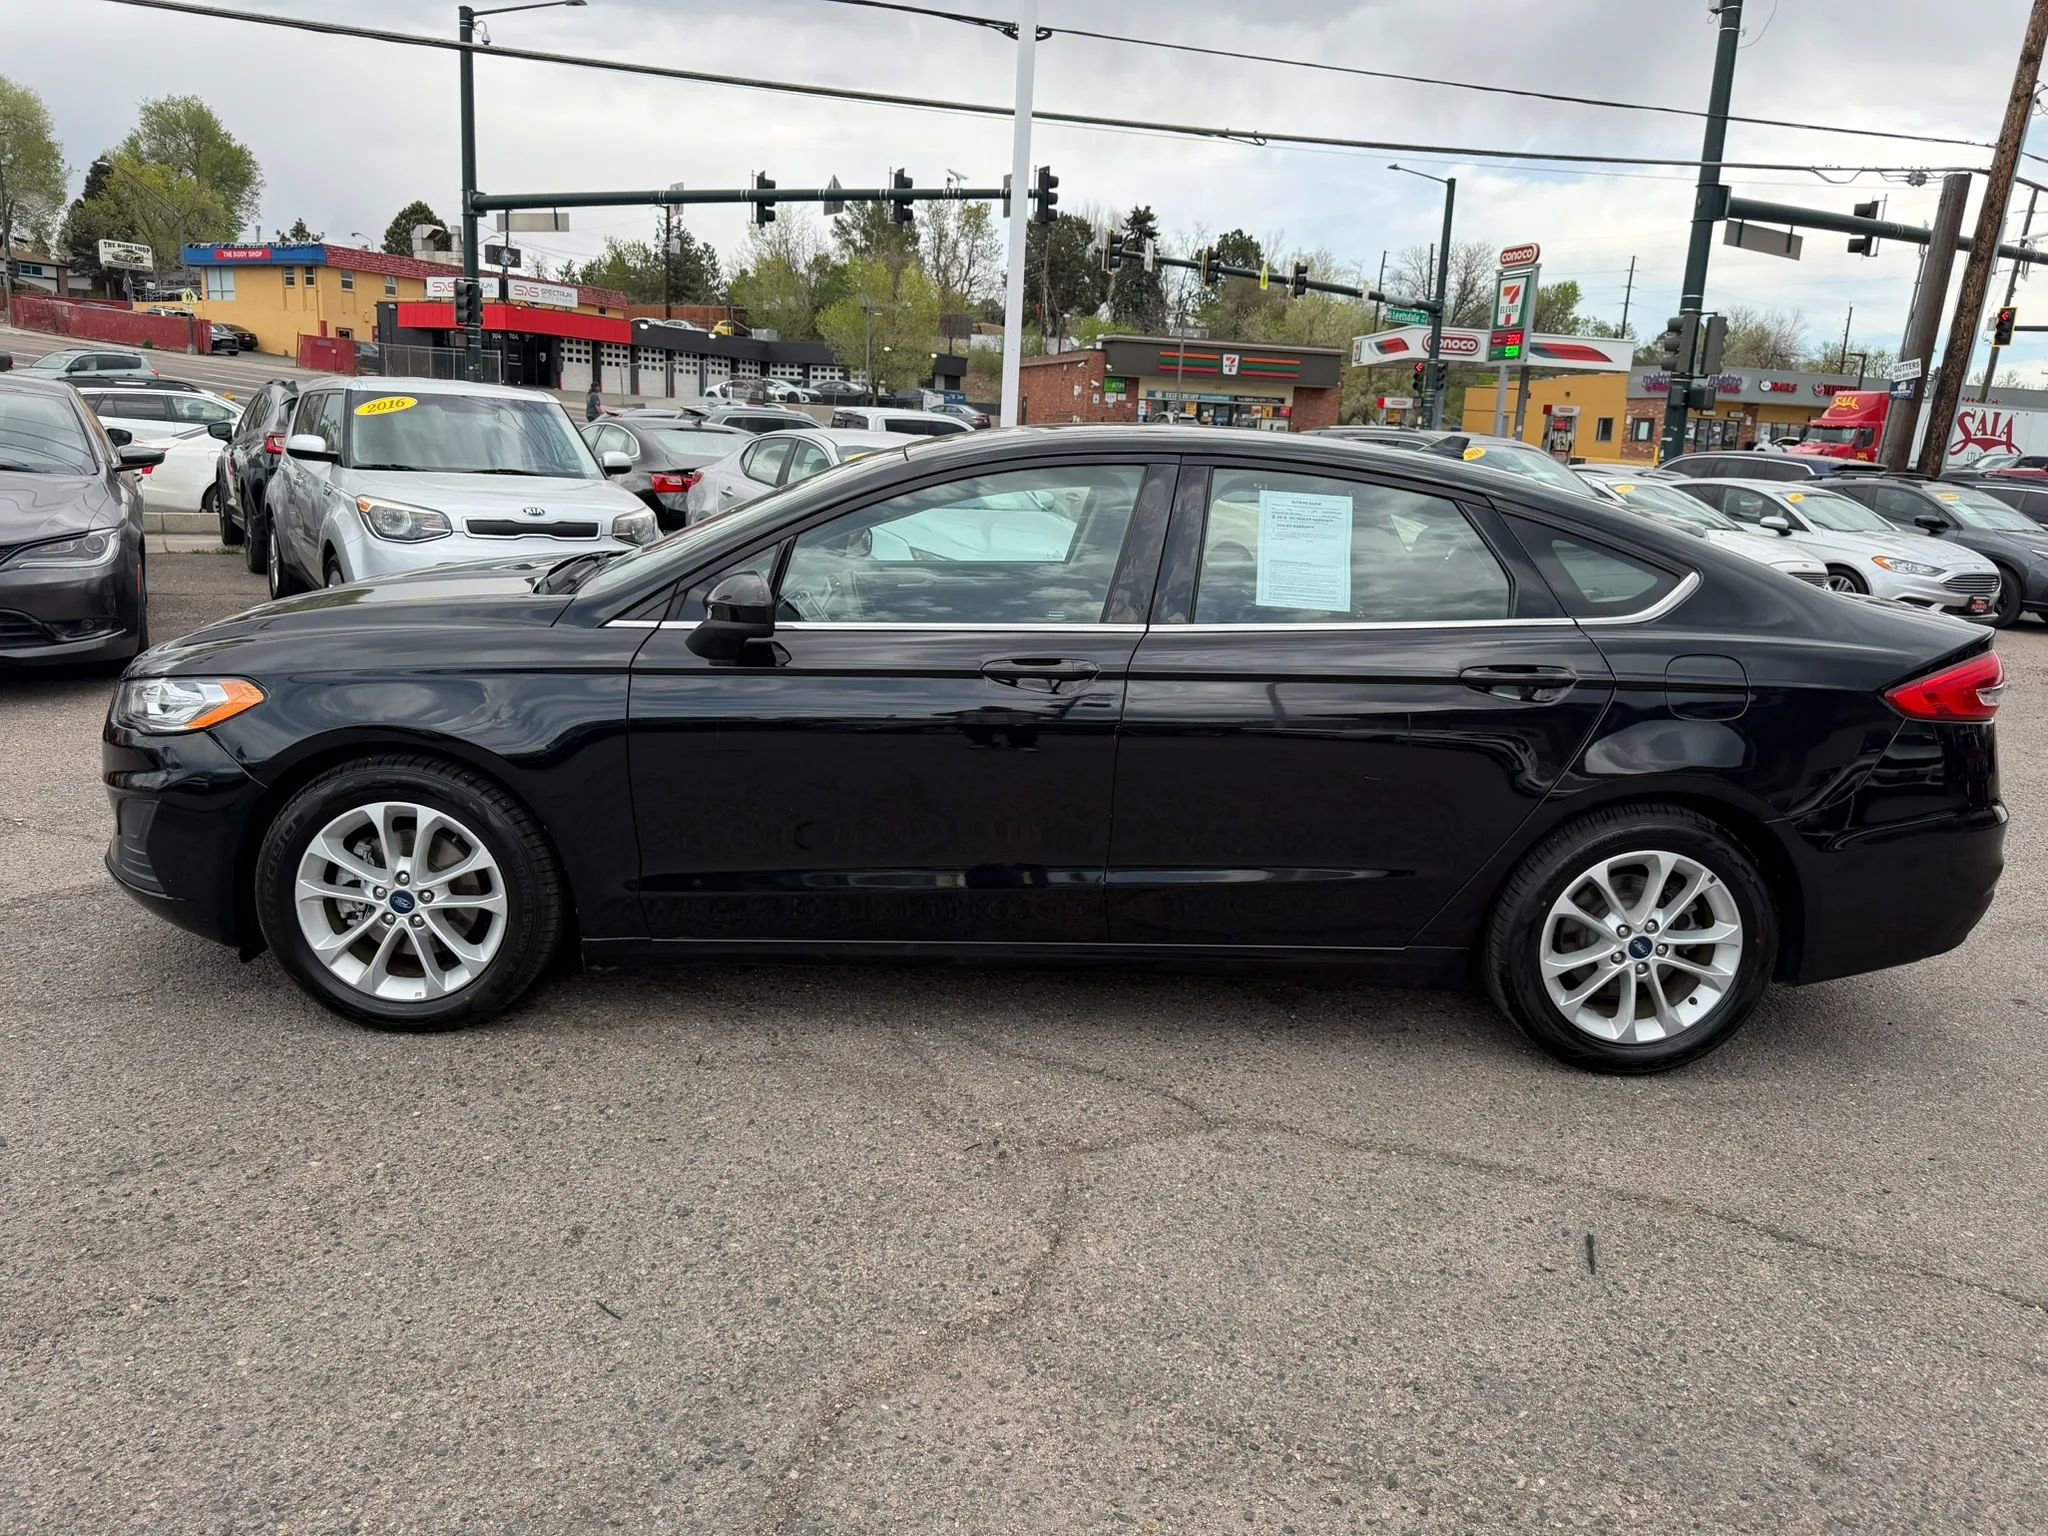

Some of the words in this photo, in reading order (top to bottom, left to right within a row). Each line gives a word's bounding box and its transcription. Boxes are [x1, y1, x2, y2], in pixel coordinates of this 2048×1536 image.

[103, 241, 116, 249] THE
[134, 245, 150, 254] SHOP
[248, 250, 263, 258] SHOP
[1501, 249, 1533, 263] conoco
[541, 287, 573, 298] SPECTRUM
[1500, 304, 1519, 315] ELEVEN
[1392, 311, 1420, 323] Leetsdale
[491, 332, 502, 340] 704
[508, 333, 519, 341] 704
[1428, 338, 1476, 350] noco
[1893, 361, 1920, 373] GUTTERS
[367, 398, 405, 413] 2016
[1949, 409, 2022, 456] SAIA
[523, 506, 545, 516] KIA
